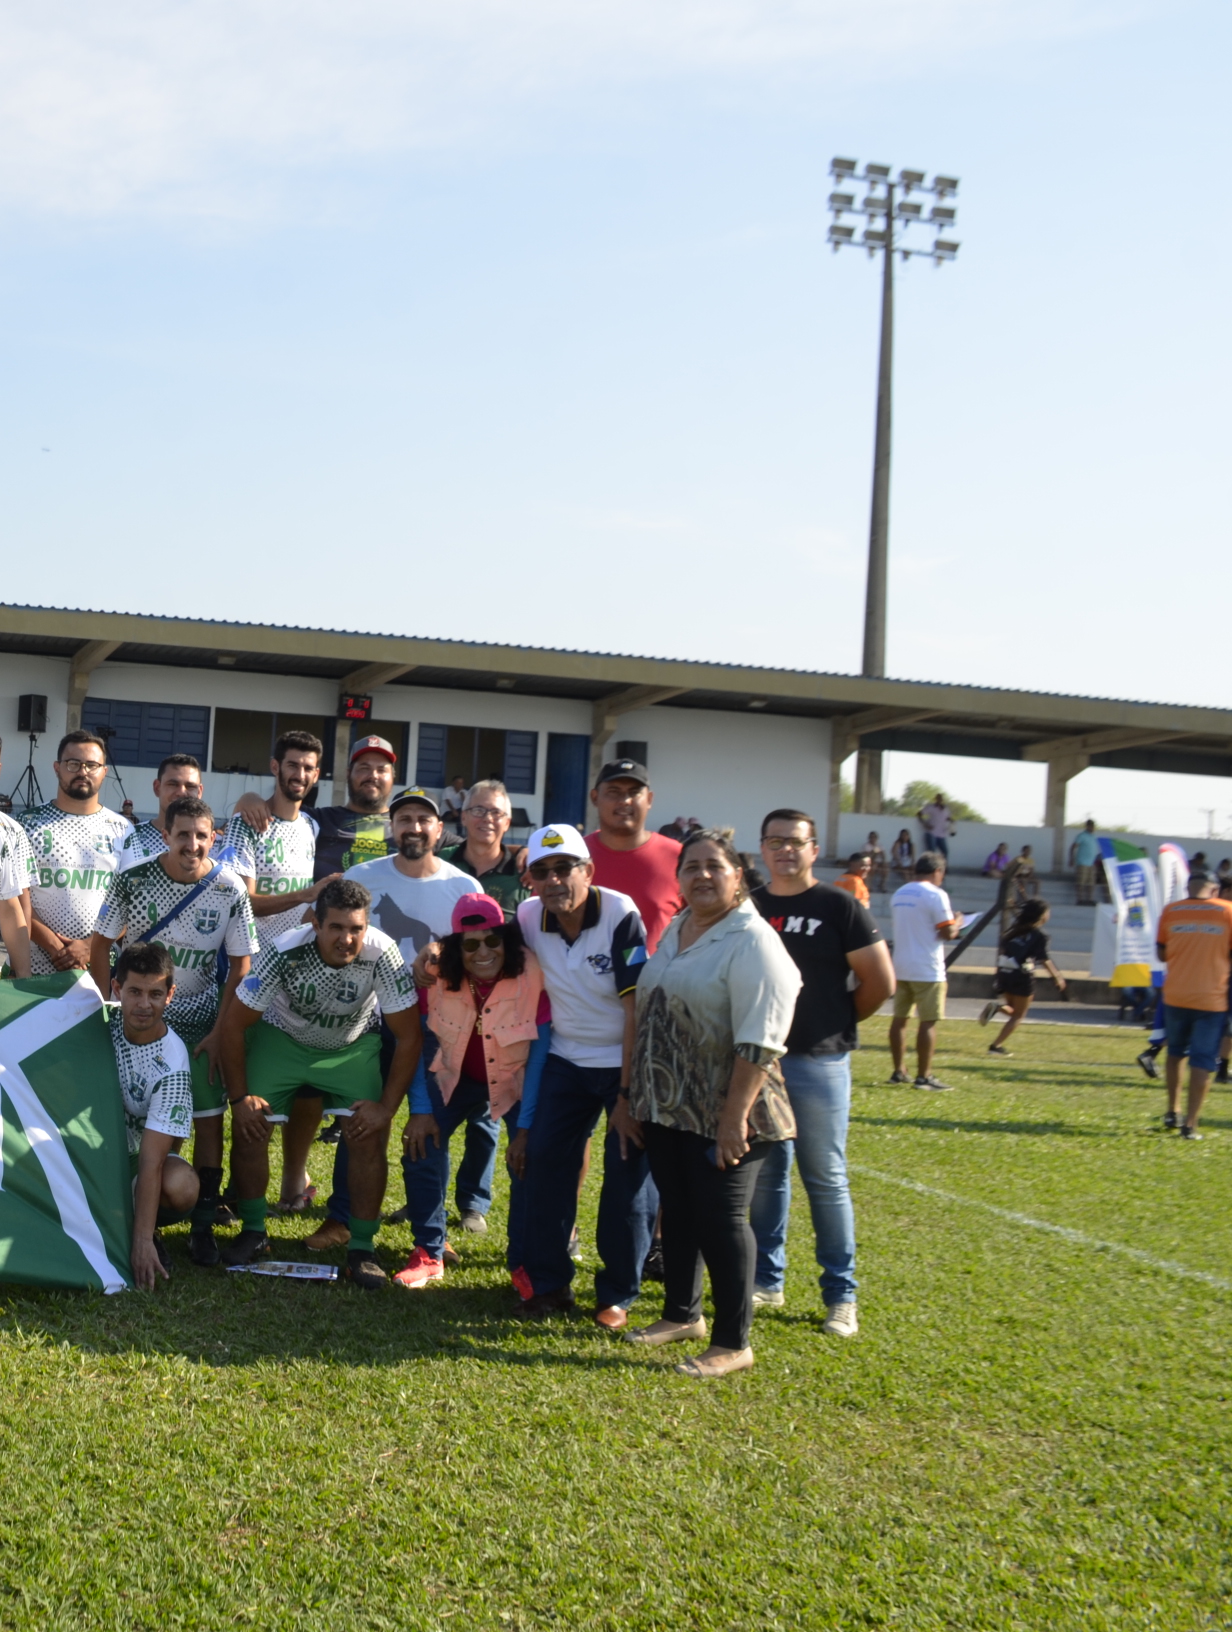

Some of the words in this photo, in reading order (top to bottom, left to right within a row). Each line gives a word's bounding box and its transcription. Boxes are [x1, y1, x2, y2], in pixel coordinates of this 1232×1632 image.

[42, 829, 53, 855] 3
[263, 837, 285, 864] 20
[351, 846, 388, 856] ESCOLARES
[353, 838, 388, 850] JOGOS
[39, 867, 115, 891] BONITO
[147, 902, 158, 928] 9
[770, 915, 823, 936] MMY
[298, 982, 316, 1006] 10
